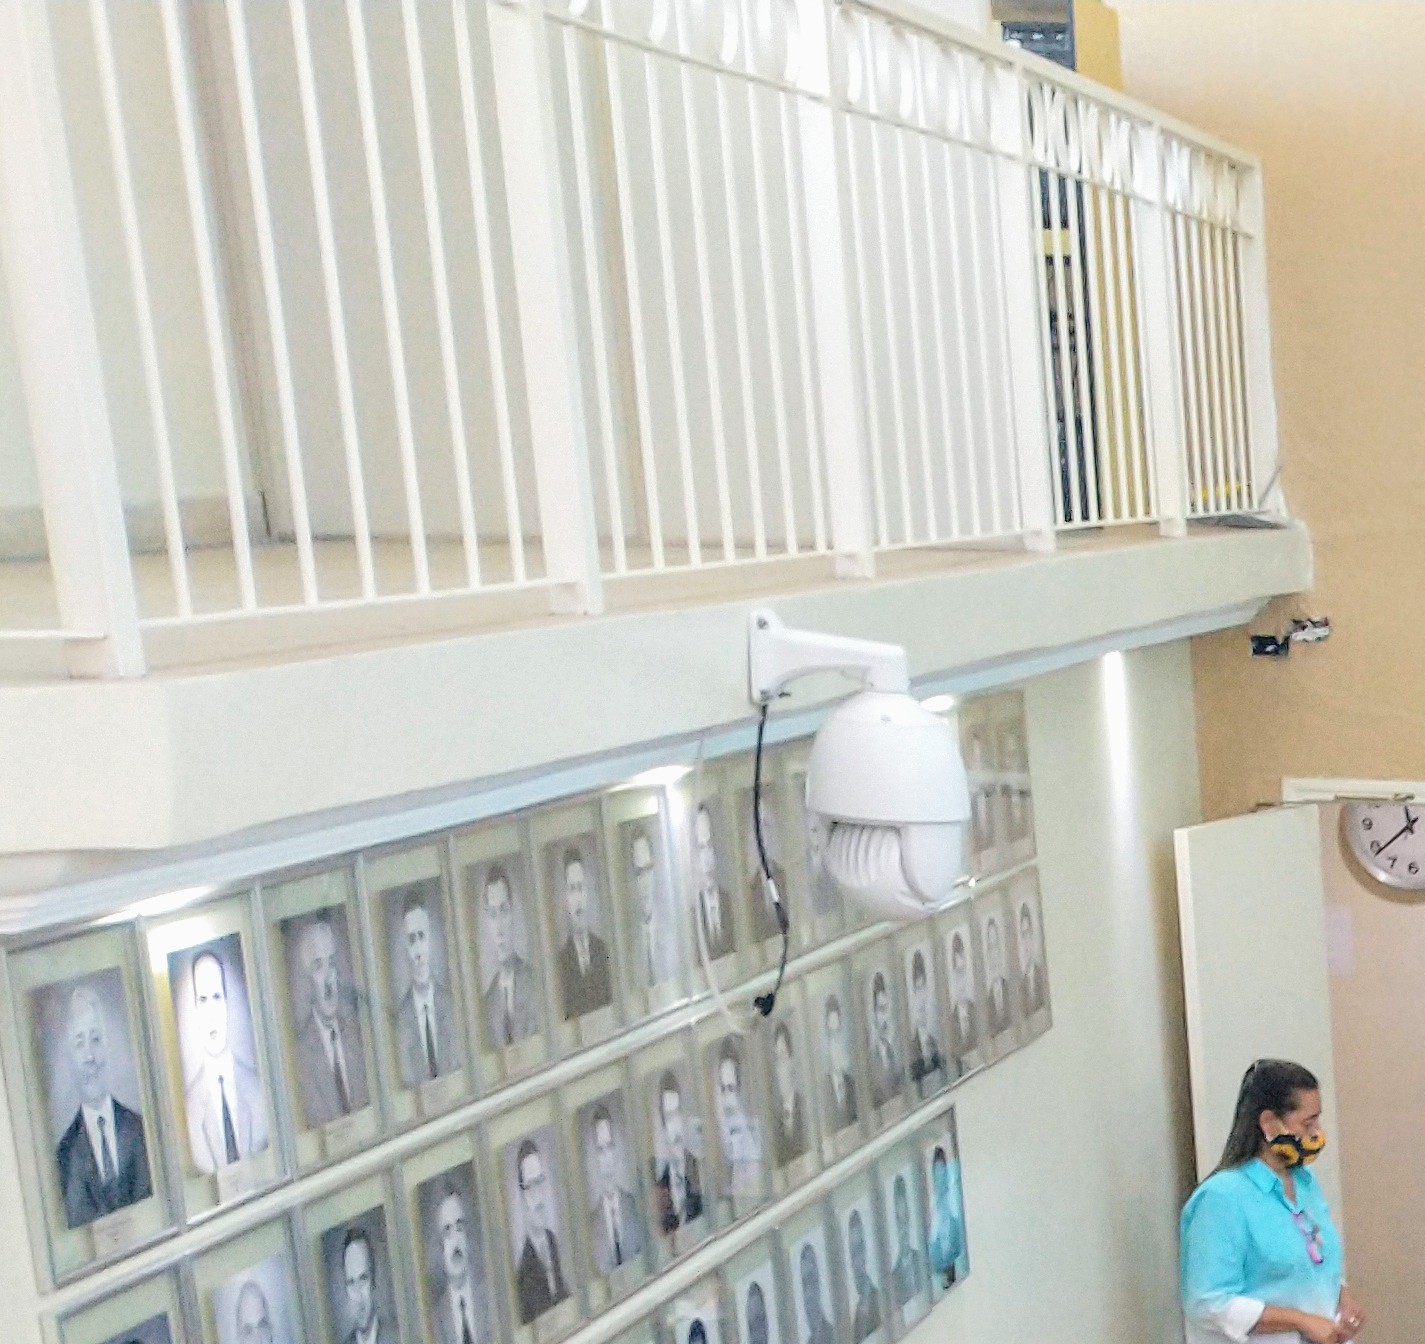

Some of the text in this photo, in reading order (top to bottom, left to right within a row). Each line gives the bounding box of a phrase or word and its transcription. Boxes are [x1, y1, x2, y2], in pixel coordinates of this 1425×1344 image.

[1361, 817, 1374, 831] 9
[1387, 856, 1398, 869] 7
[1407, 861, 1421, 875] 6
